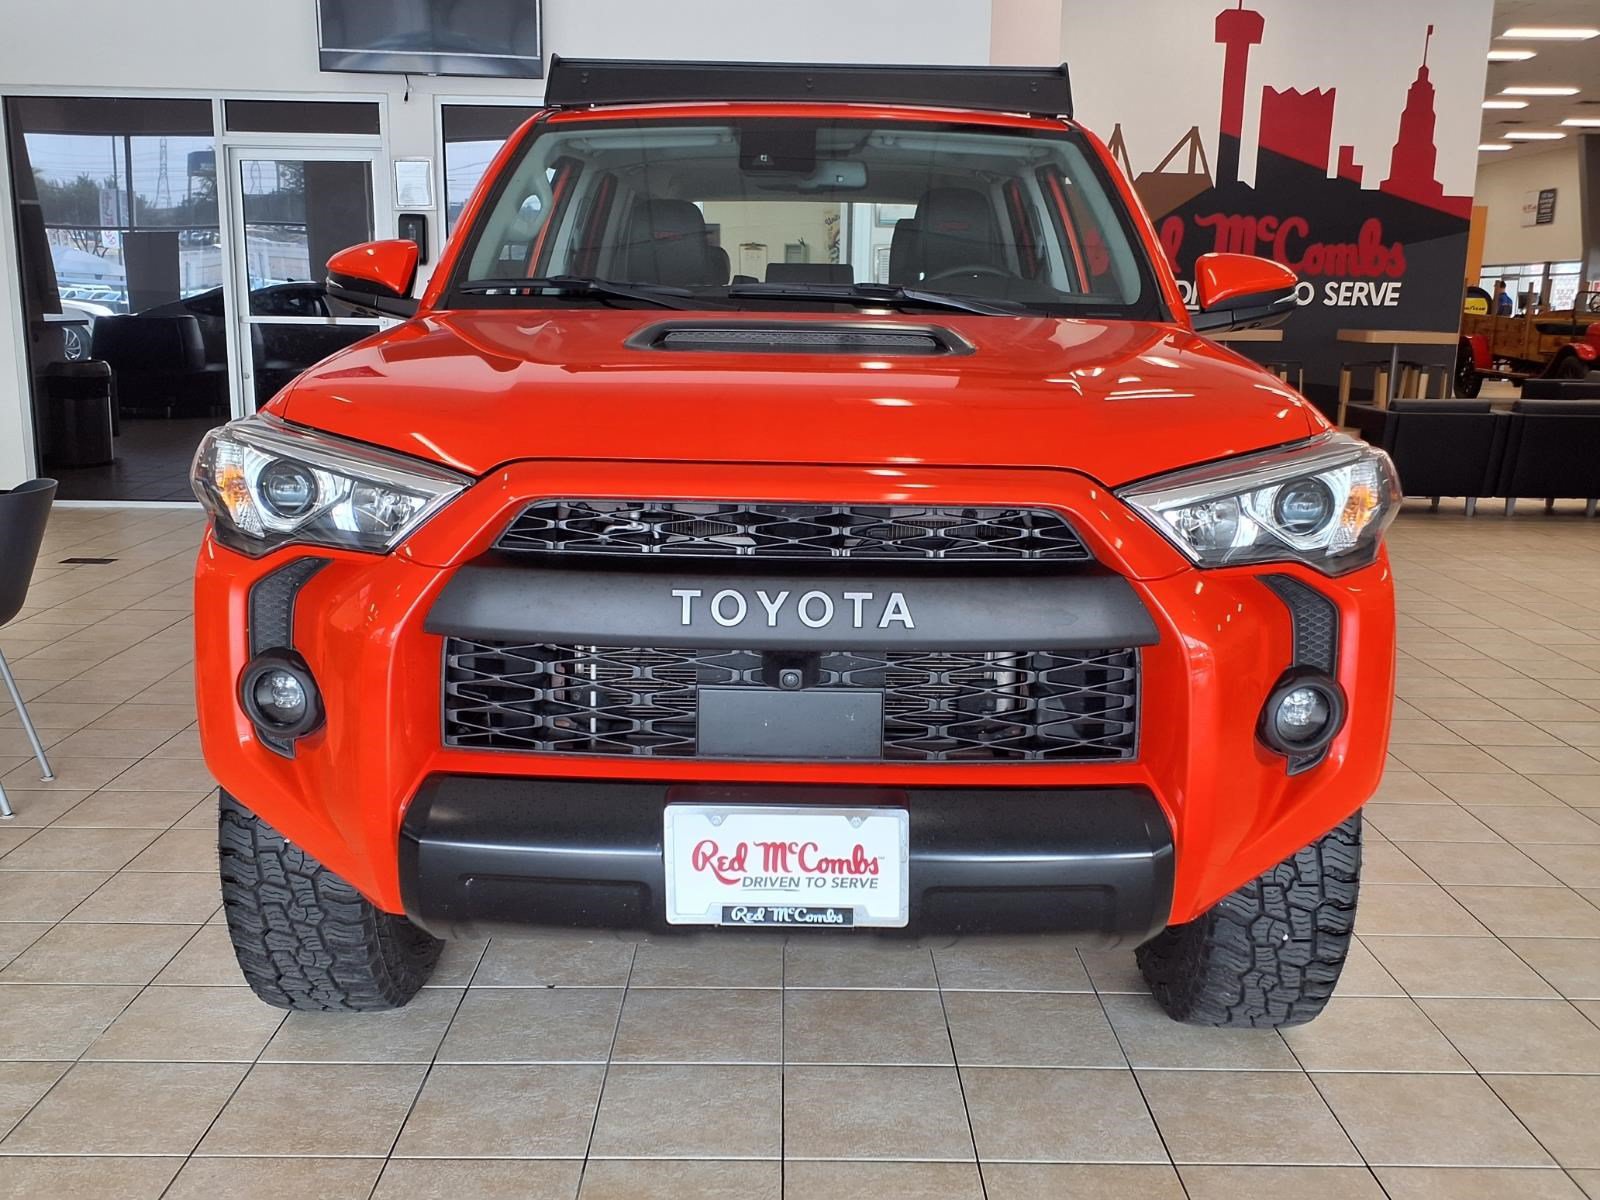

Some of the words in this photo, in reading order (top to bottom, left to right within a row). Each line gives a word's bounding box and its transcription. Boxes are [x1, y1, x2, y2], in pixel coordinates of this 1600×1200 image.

[1194, 213, 1407, 278] McCombs
[1296, 281, 1315, 306] O
[1323, 281, 1402, 307] SERVE
[671, 589, 915, 628] TOYOTA
[691, 839, 748, 885] Red
[753, 841, 879, 875] McCombs
[742, 876, 801, 888] DRIVEN
[805, 877, 827, 888] TO
[831, 877, 879, 889] SERVE
[731, 906, 765, 924] Red
[767, 907, 844, 924] McCombs
